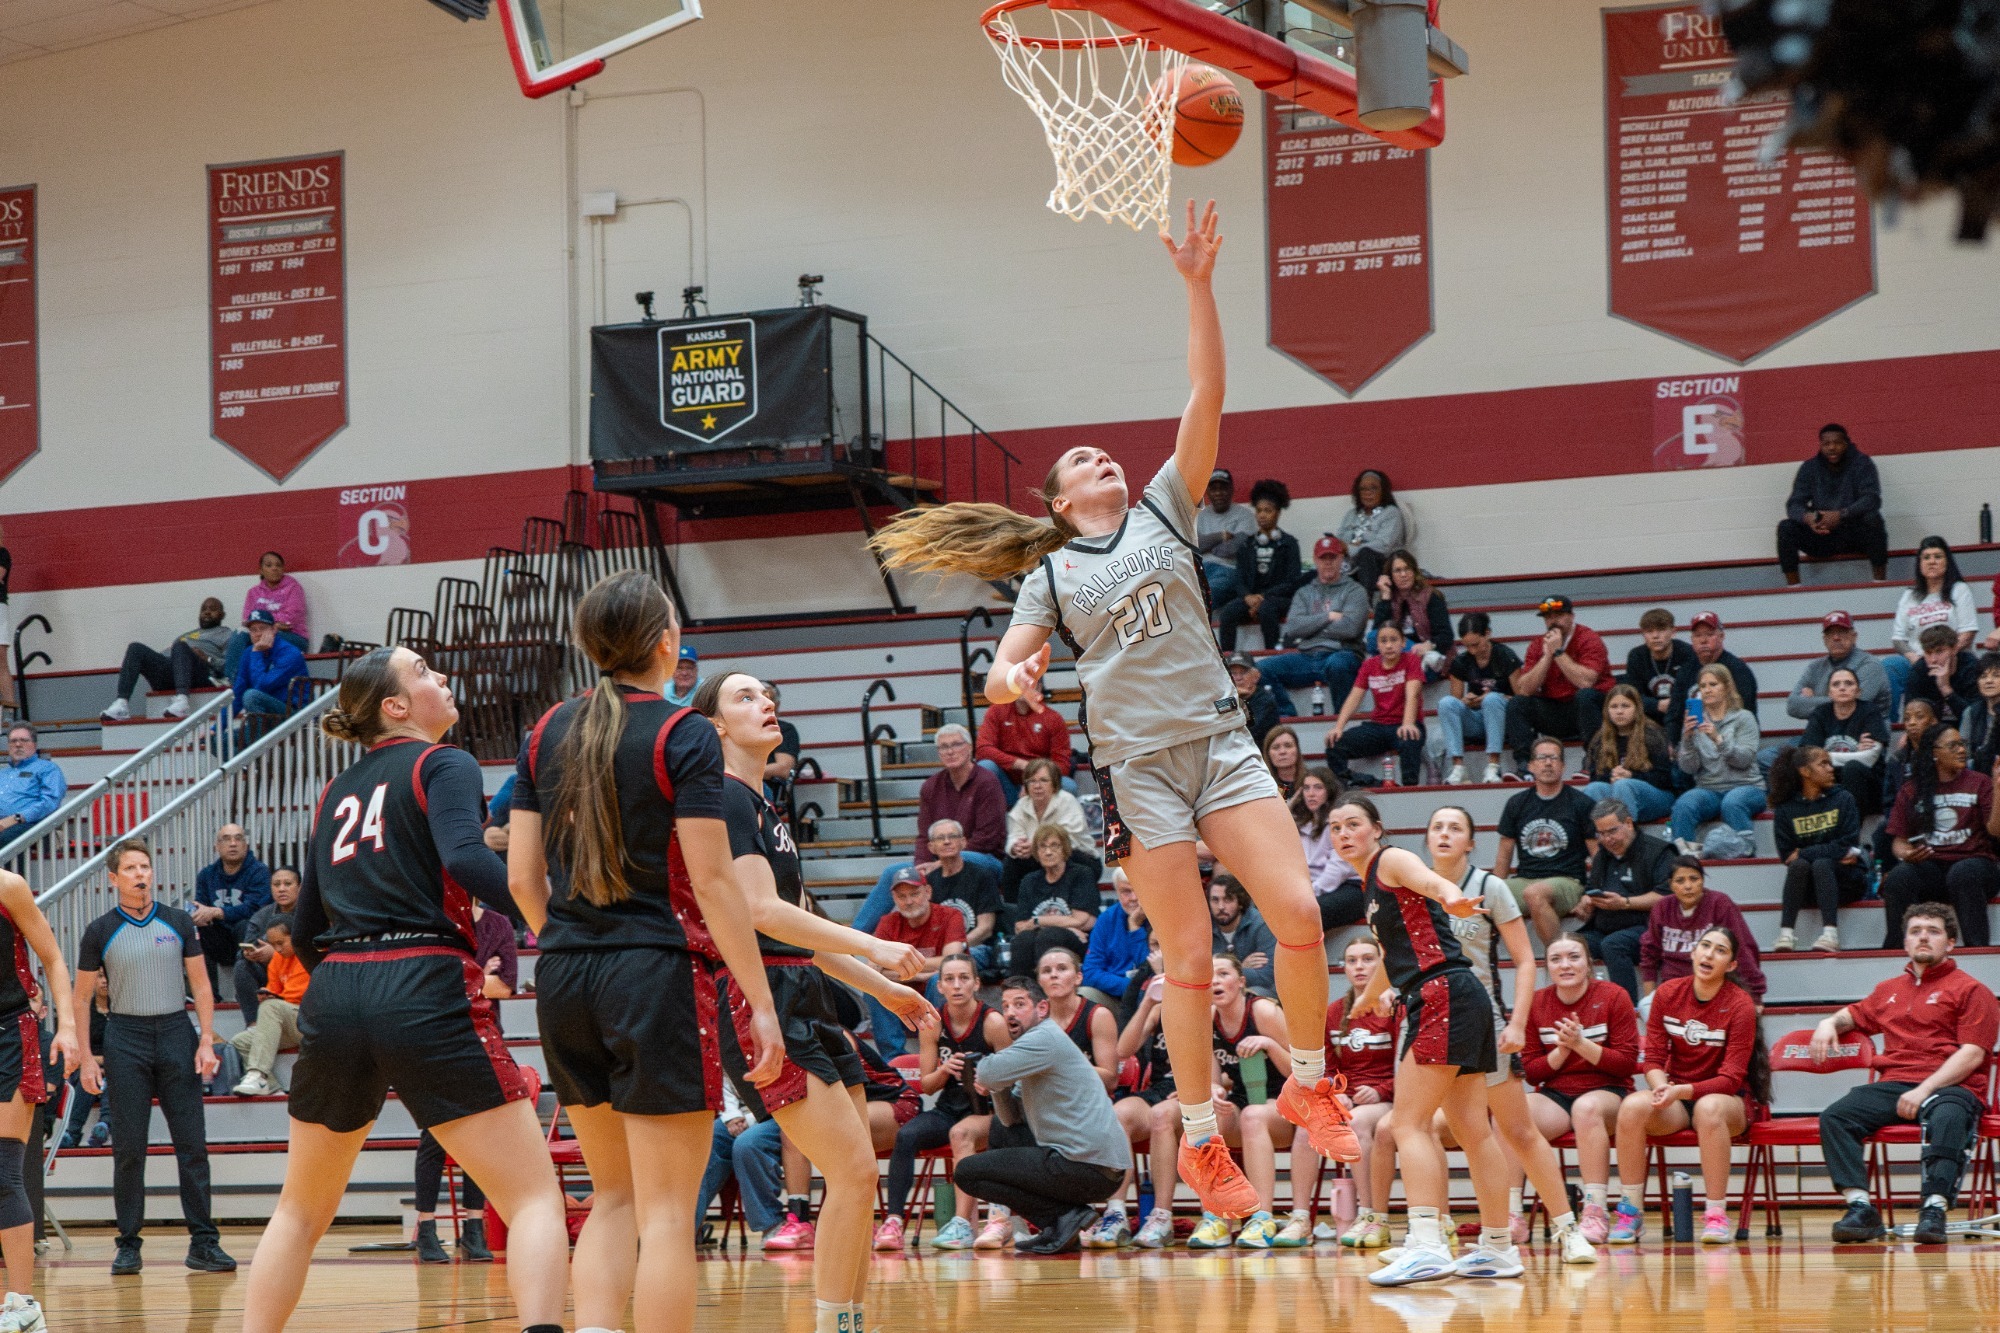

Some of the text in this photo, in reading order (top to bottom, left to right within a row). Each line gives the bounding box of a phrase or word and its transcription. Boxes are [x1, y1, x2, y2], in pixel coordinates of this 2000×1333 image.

[1276, 156, 1305, 171] 2012
[1313, 153, 1343, 168] 2015
[1351, 149, 1380, 164] 2016
[220, 165, 330, 199] FRIENDS
[1274, 173, 1304, 187] 2023
[219, 190, 330, 214] UNIVERSITY
[260, 242, 295, 254] SOCCER
[1278, 234, 1421, 258] KCAC OUTDOOR CHAMPIONS
[1278, 252, 1422, 278] 2012 2013 2015 2016
[232, 290, 282, 305] VOLLEYBALL
[231, 338, 282, 354] VOLLEYBALL
[686, 330, 727, 343] KANSAS
[672, 345, 742, 372] ARMY
[671, 366, 744, 386] NATIONAL
[1656, 376, 1740, 399] SECTION
[219, 389, 259, 402] SOFTBALL
[671, 382, 746, 407] GUARD
[1683, 404, 1718, 456] E
[340, 485, 406, 506] SECTION
[358, 509, 390, 556] C
[1072, 546, 1174, 616] FALCONS
[1107, 581, 1173, 650] 20
[331, 782, 390, 866] 24
